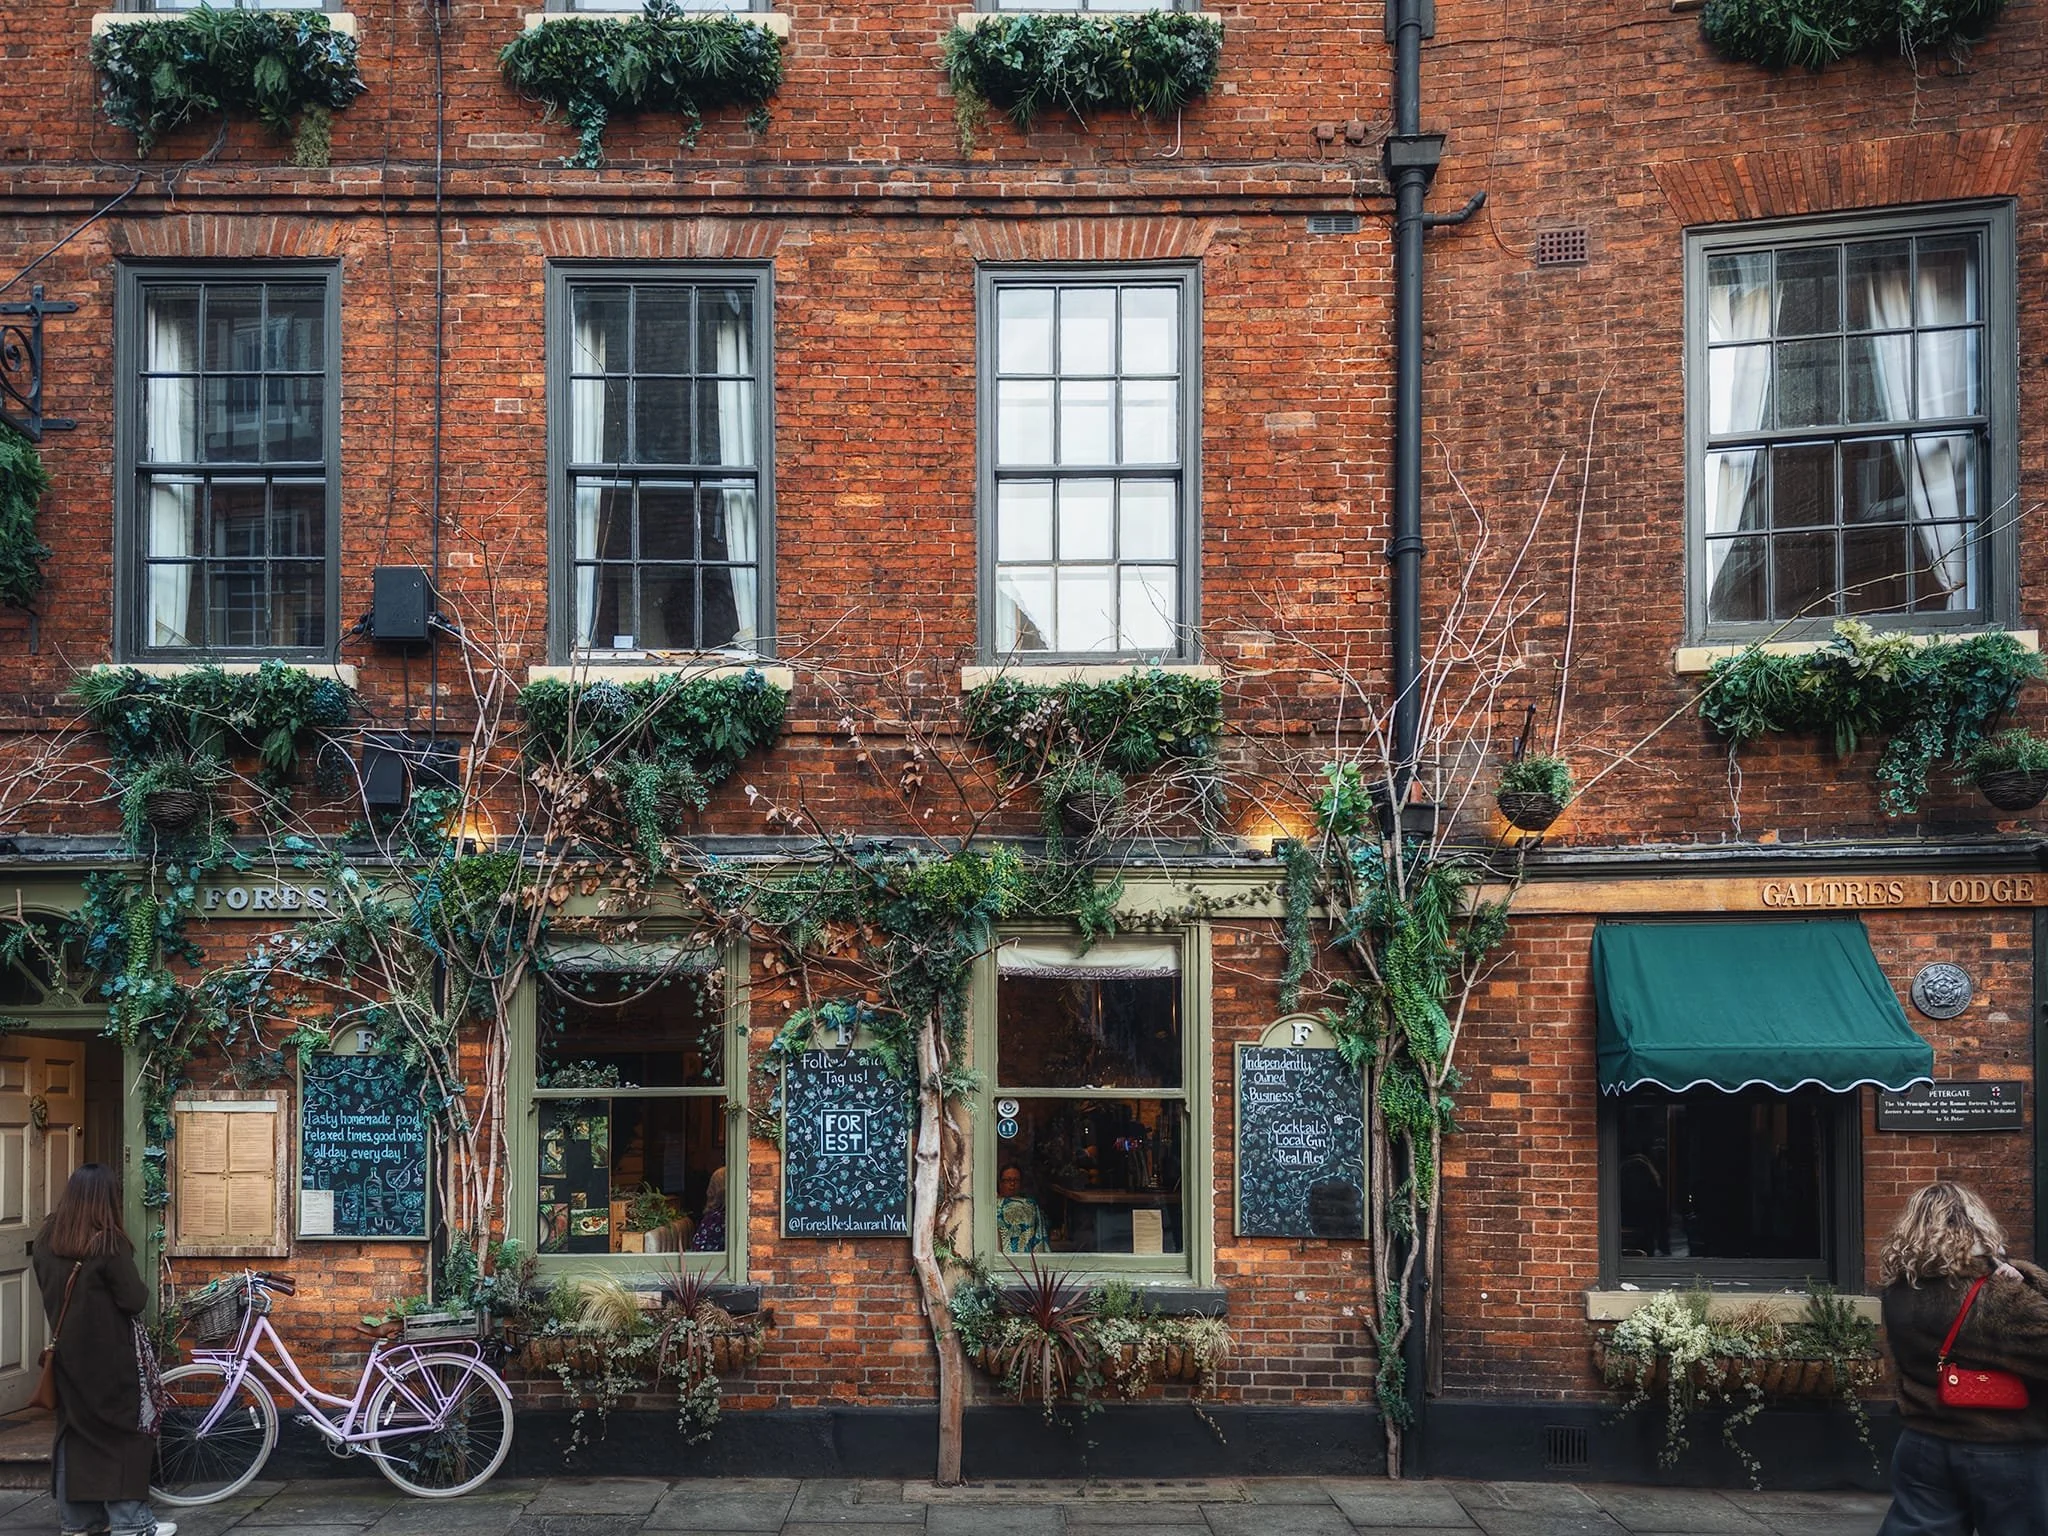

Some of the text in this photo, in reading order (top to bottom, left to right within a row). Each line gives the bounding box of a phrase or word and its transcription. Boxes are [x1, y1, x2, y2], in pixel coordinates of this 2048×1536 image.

[1762, 878, 2035, 907] GALTRES LODGE
[356, 1030, 378, 1053] F
[1291, 1022, 1314, 1046] F
[1245, 1052, 1312, 1077] Independently
[821, 1069, 868, 1088] Tag us!
[1254, 1068, 1287, 1086] Owned
[1249, 1087, 1295, 1103] Business
[1929, 1090, 1970, 1098] PETERGATE
[304, 1110, 338, 1128] Tasty
[340, 1109, 391, 1124] homemade
[825, 1114, 862, 1132] FOR
[1271, 1118, 1327, 1135] Cocktails
[304, 1127, 345, 1141] relaxed
[373, 1128, 396, 1145] good
[398, 1127, 424, 1142] vibes
[825, 1134, 863, 1151] EST
[1275, 1133, 1327, 1149] Local Gin
[1278, 1149, 1302, 1165] Real
